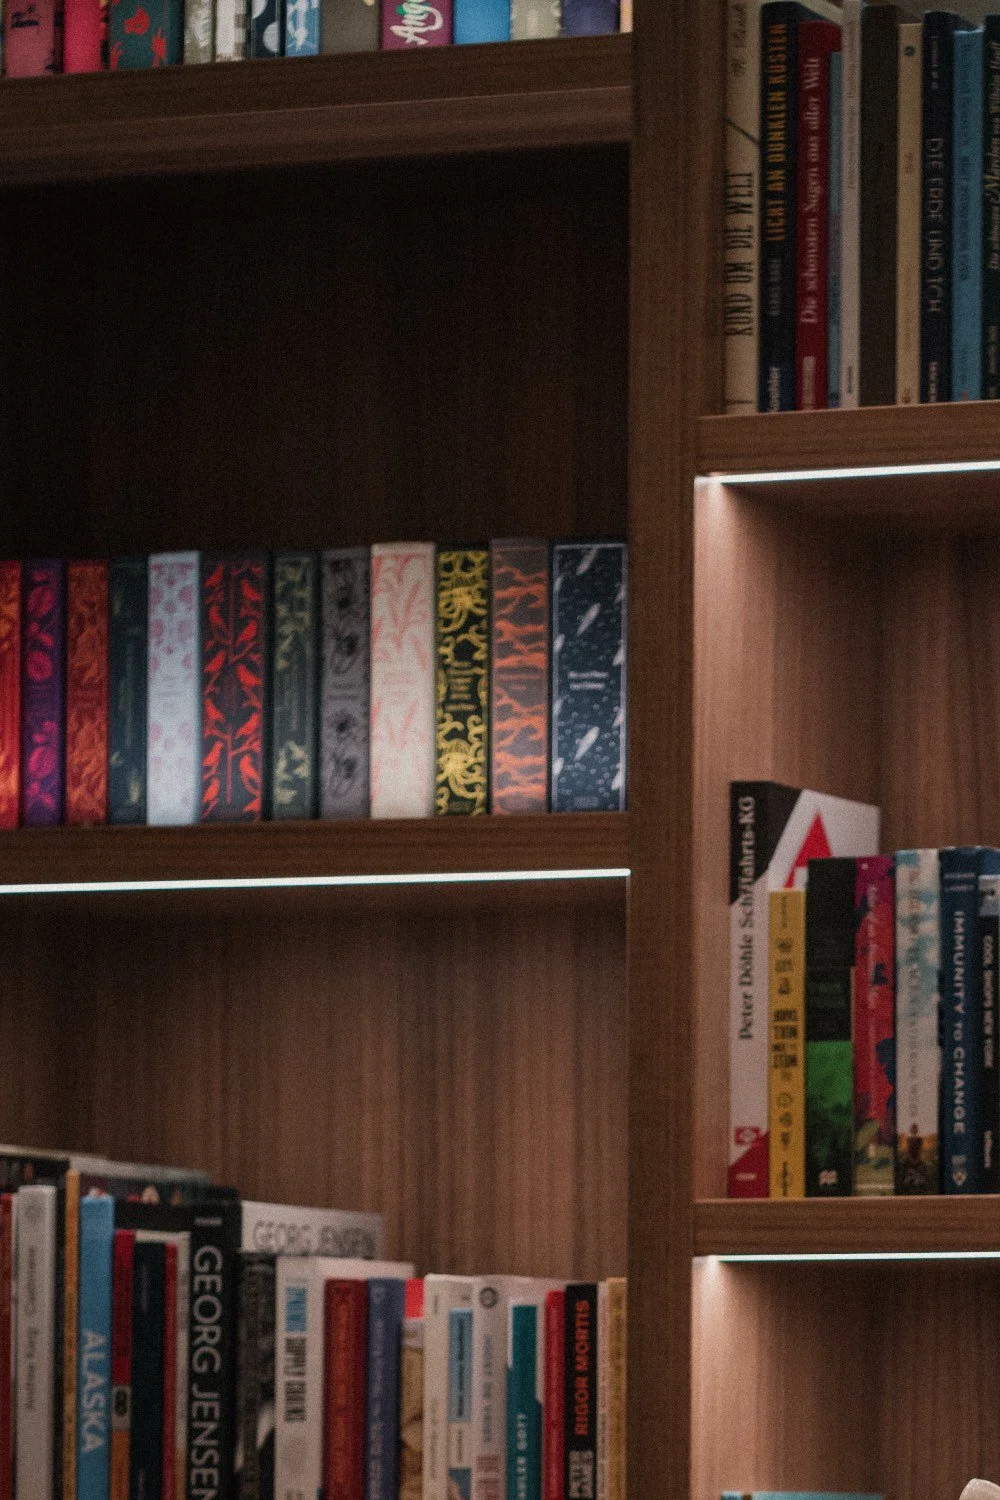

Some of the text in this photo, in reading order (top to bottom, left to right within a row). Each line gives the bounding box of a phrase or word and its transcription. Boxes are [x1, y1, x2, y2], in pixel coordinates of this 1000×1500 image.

[800, 58, 822, 91] Welt
[800, 97, 822, 132] aller
[764, 91, 788, 164] DUNKLEN
[764, 170, 788, 191] AN
[800, 165, 822, 213] Sagen
[724, 170, 753, 337] RUND UM DIE WELT
[926, 137, 945, 314] DIE ERDE UND ICH
[800, 300, 822, 324] Die
[737, 934, 757, 1040] Peter Döhle
[952, 911, 966, 1015] IMMUNITY
[952, 1046, 966, 1135] CHANGE
[192, 1244, 223, 1373] GEORG
[81, 1329, 105, 1452] ALASKA
[574, 1301, 590, 1438] RIGOR MORTIS
[515, 1413, 527, 1451] GOTT
